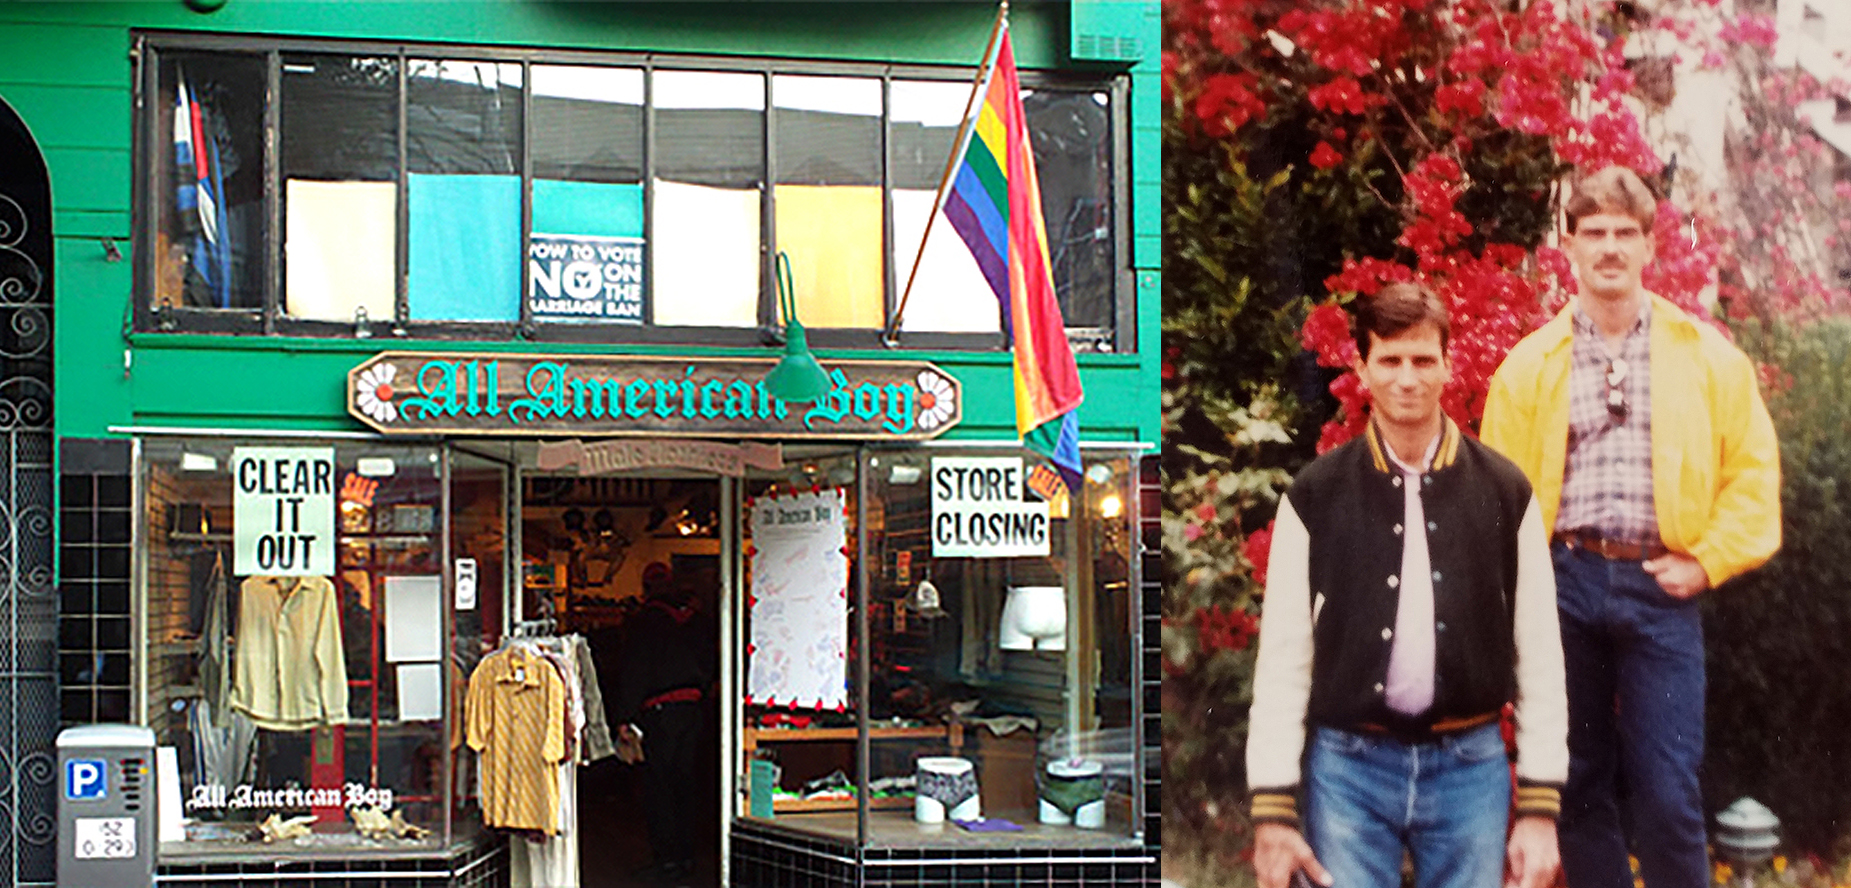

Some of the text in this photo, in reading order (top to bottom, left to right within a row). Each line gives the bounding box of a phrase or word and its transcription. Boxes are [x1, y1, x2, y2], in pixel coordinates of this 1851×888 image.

[571, 244, 595, 261] TO
[597, 246, 642, 263] VOTE
[529, 259, 603, 300] NO
[603, 261, 642, 283] ON
[603, 281, 641, 301] THE
[606, 301, 642, 317] BAN
[400, 359, 915, 435] All American Boy
[238, 457, 331, 495] CLEAR
[340, 472, 379, 508] SALE
[936, 466, 1018, 502] STORE
[275, 497, 304, 533] IT
[936, 511, 1046, 547] CLOSING
[257, 534, 317, 571] OUT
[73, 763, 99, 796] P
[185, 781, 394, 812] All American Boy
